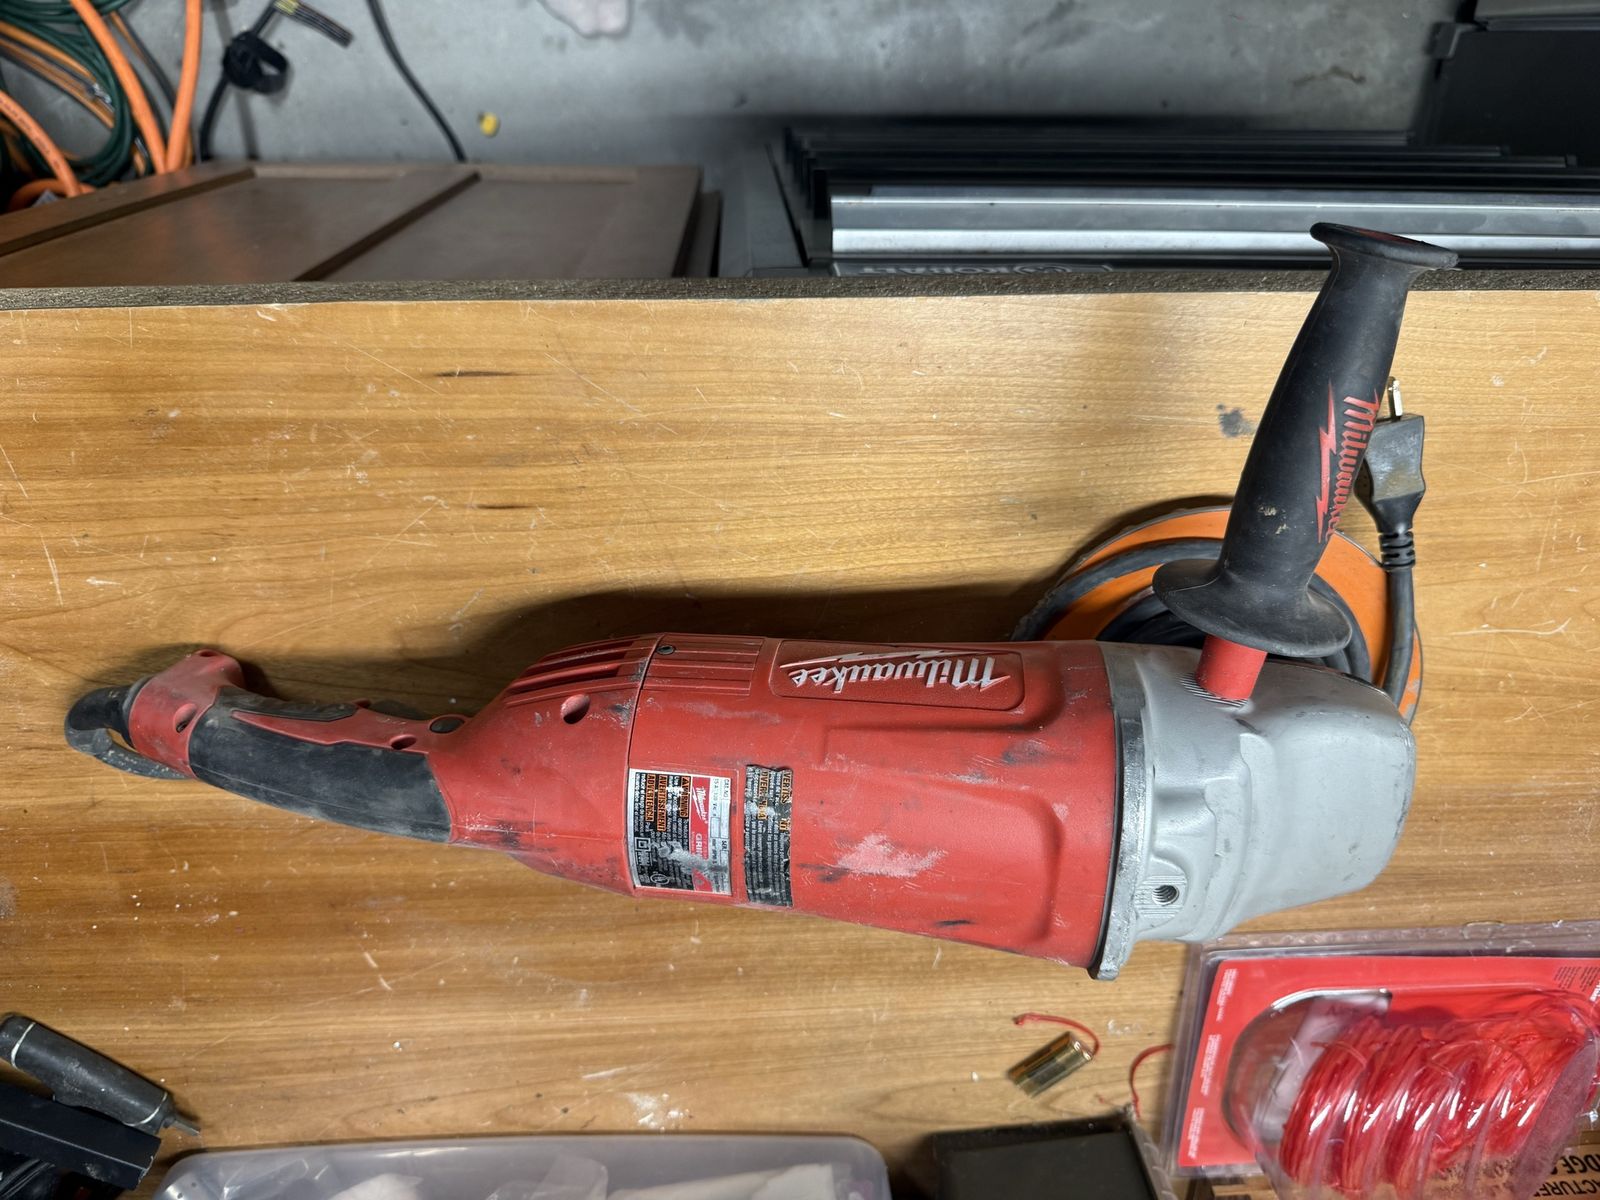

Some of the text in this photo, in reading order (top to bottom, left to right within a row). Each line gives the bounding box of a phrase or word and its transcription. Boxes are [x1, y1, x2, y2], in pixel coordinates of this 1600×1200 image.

[788, 656, 1010, 694] Milwaukee
[646, 774, 655, 821] ADVERTENCIA
[657, 775, 667, 830] AVERTISSEMENT
